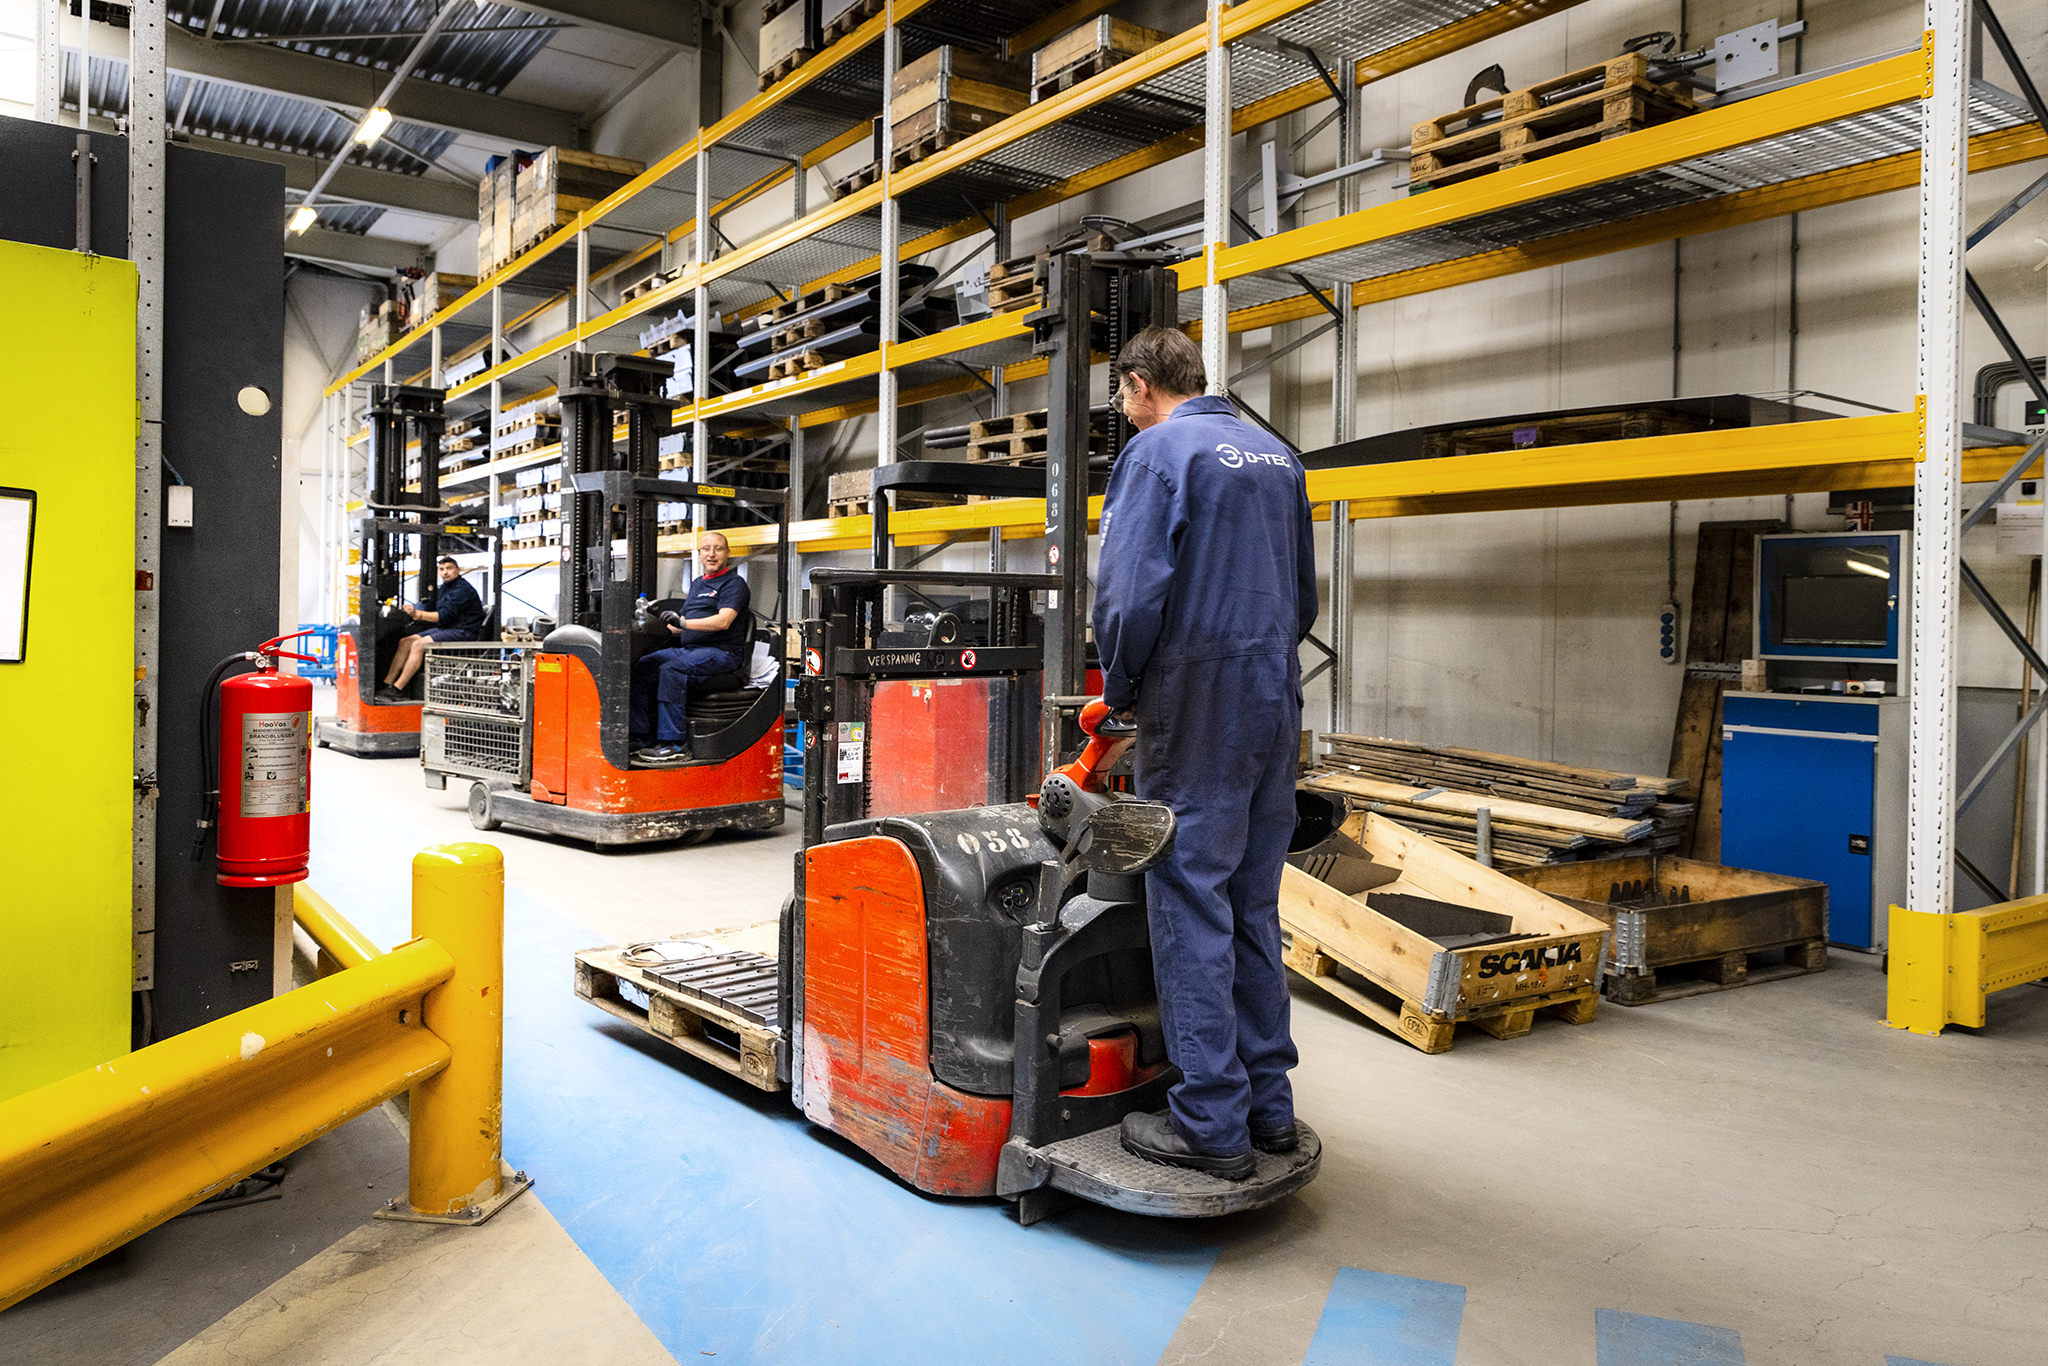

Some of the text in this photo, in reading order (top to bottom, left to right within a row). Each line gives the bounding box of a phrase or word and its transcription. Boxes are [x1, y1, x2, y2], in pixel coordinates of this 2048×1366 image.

[1243, 451, 1291, 468] D-TEC
[1051, 462, 1060, 518] 068
[867, 651, 921, 667] VERSPANING
[957, 827, 1031, 855] 058
[1478, 942, 1581, 979] SCANIA
[1563, 974, 1580, 984] 2022
